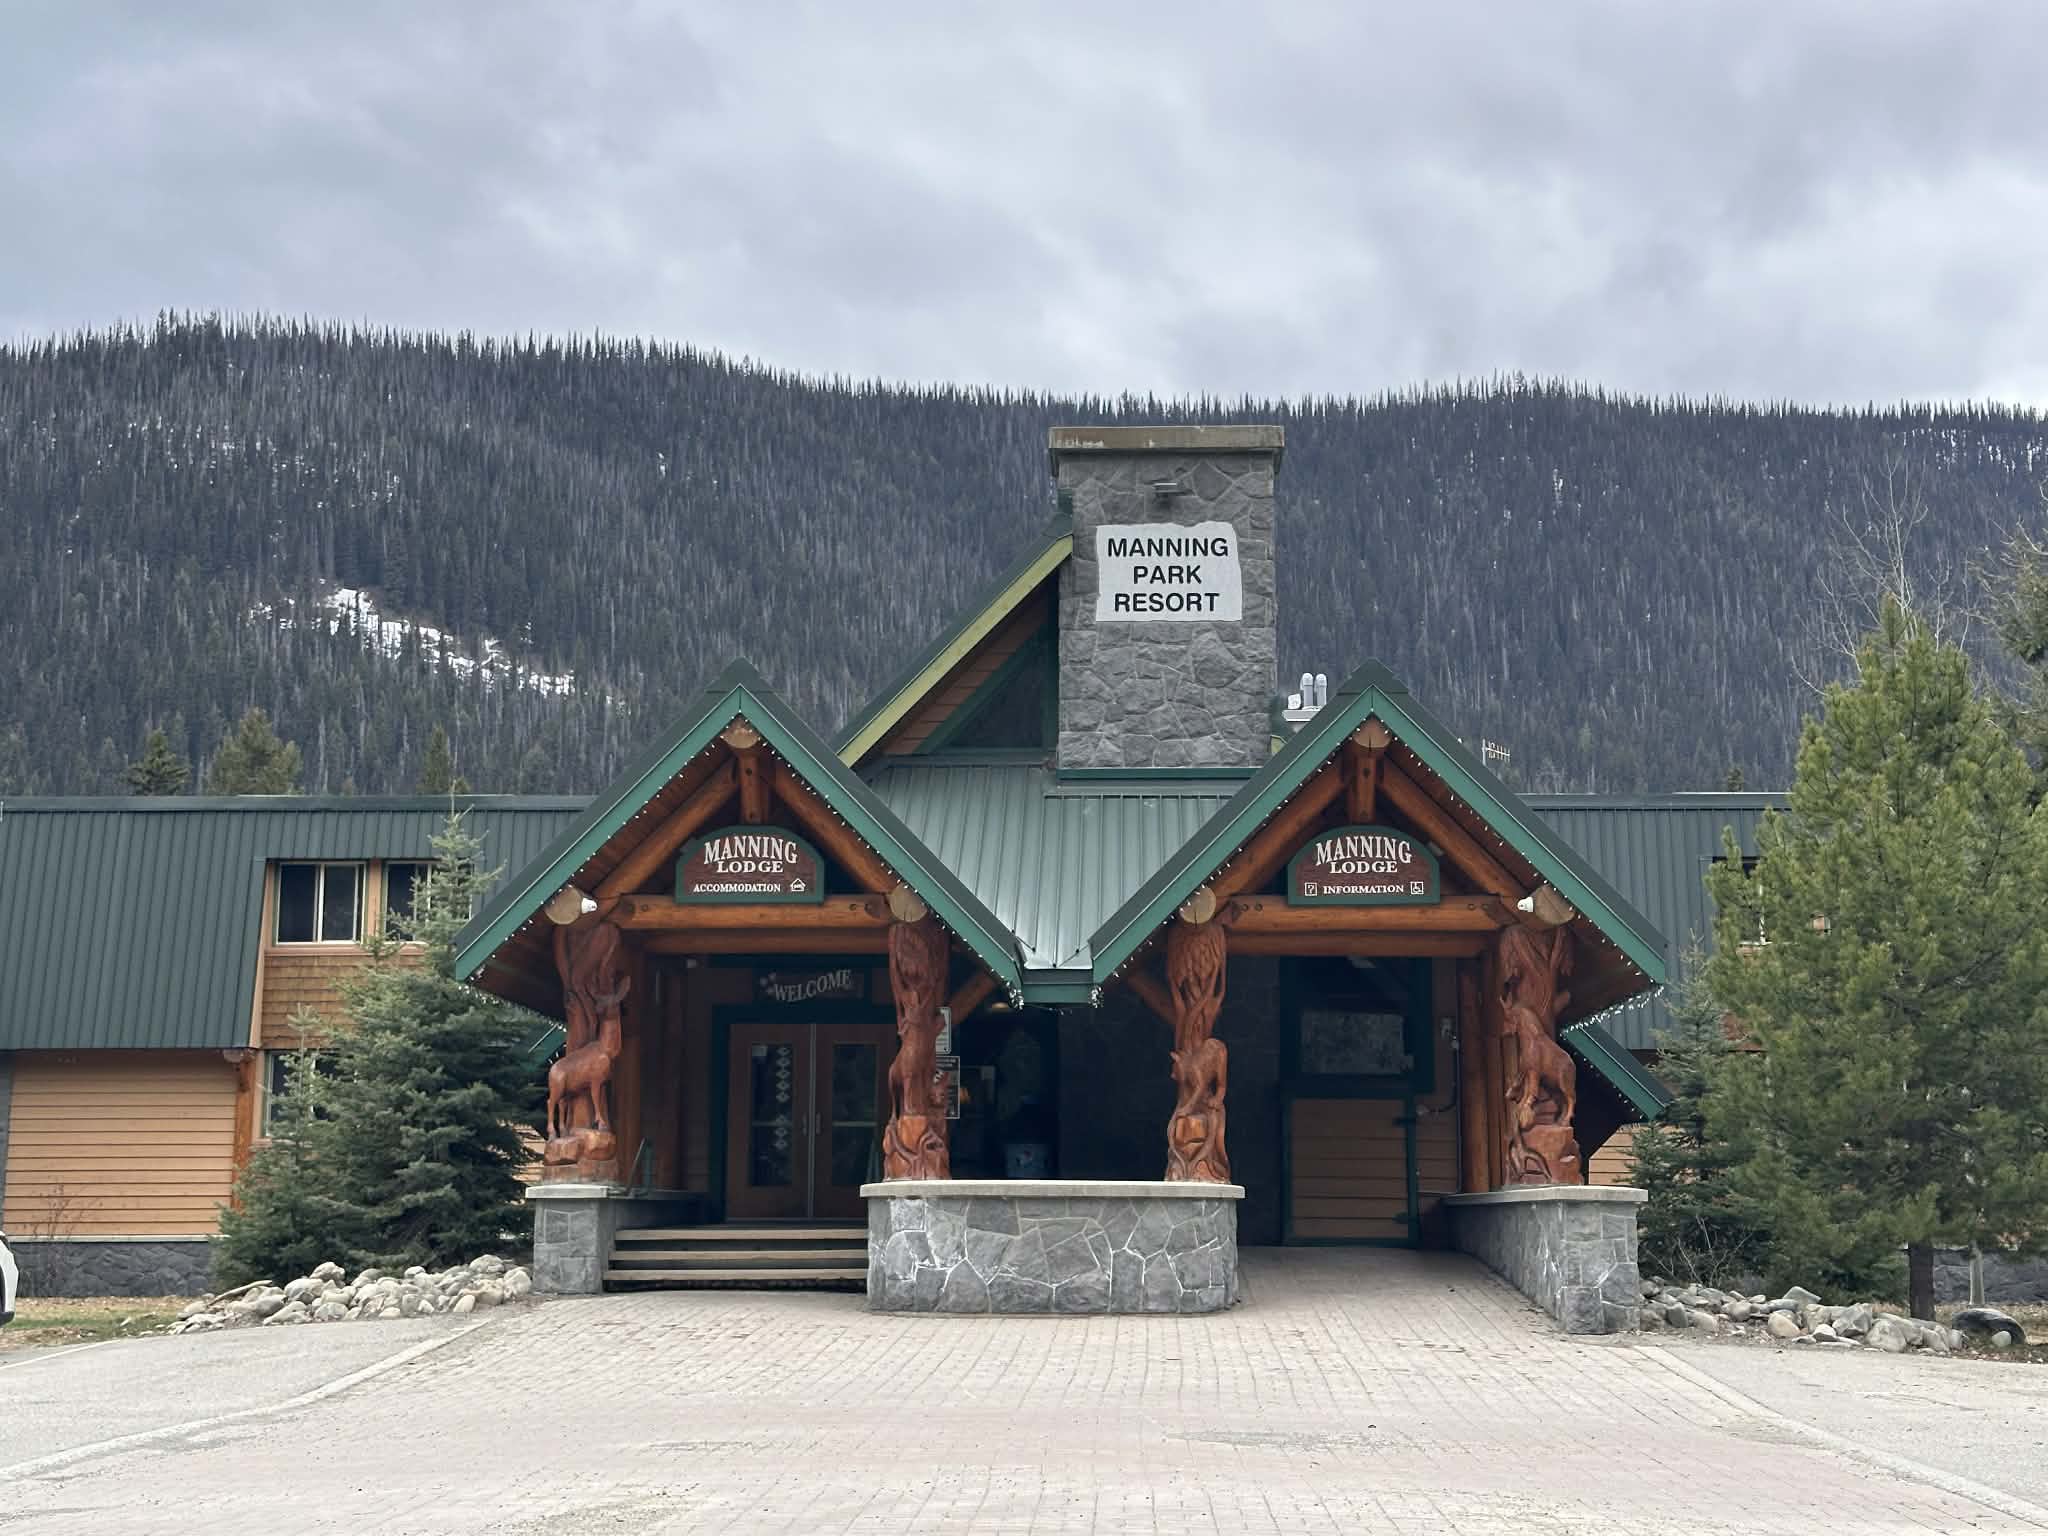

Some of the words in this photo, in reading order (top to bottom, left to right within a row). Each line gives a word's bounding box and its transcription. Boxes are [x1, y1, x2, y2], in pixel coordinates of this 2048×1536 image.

[1107, 537, 1229, 557] MANNING
[1133, 565, 1202, 584] PARK
[1114, 592, 1220, 612] RESORT
[703, 835, 798, 865] MANNING
[1315, 835, 1413, 866] MANNING
[716, 860, 784, 873] LODGE
[1329, 860, 1398, 874] LODGE
[693, 883, 781, 893] ACCOMMODATION
[1323, 884, 1404, 895] INFORMATION
[774, 969, 852, 1002] WELCOME
